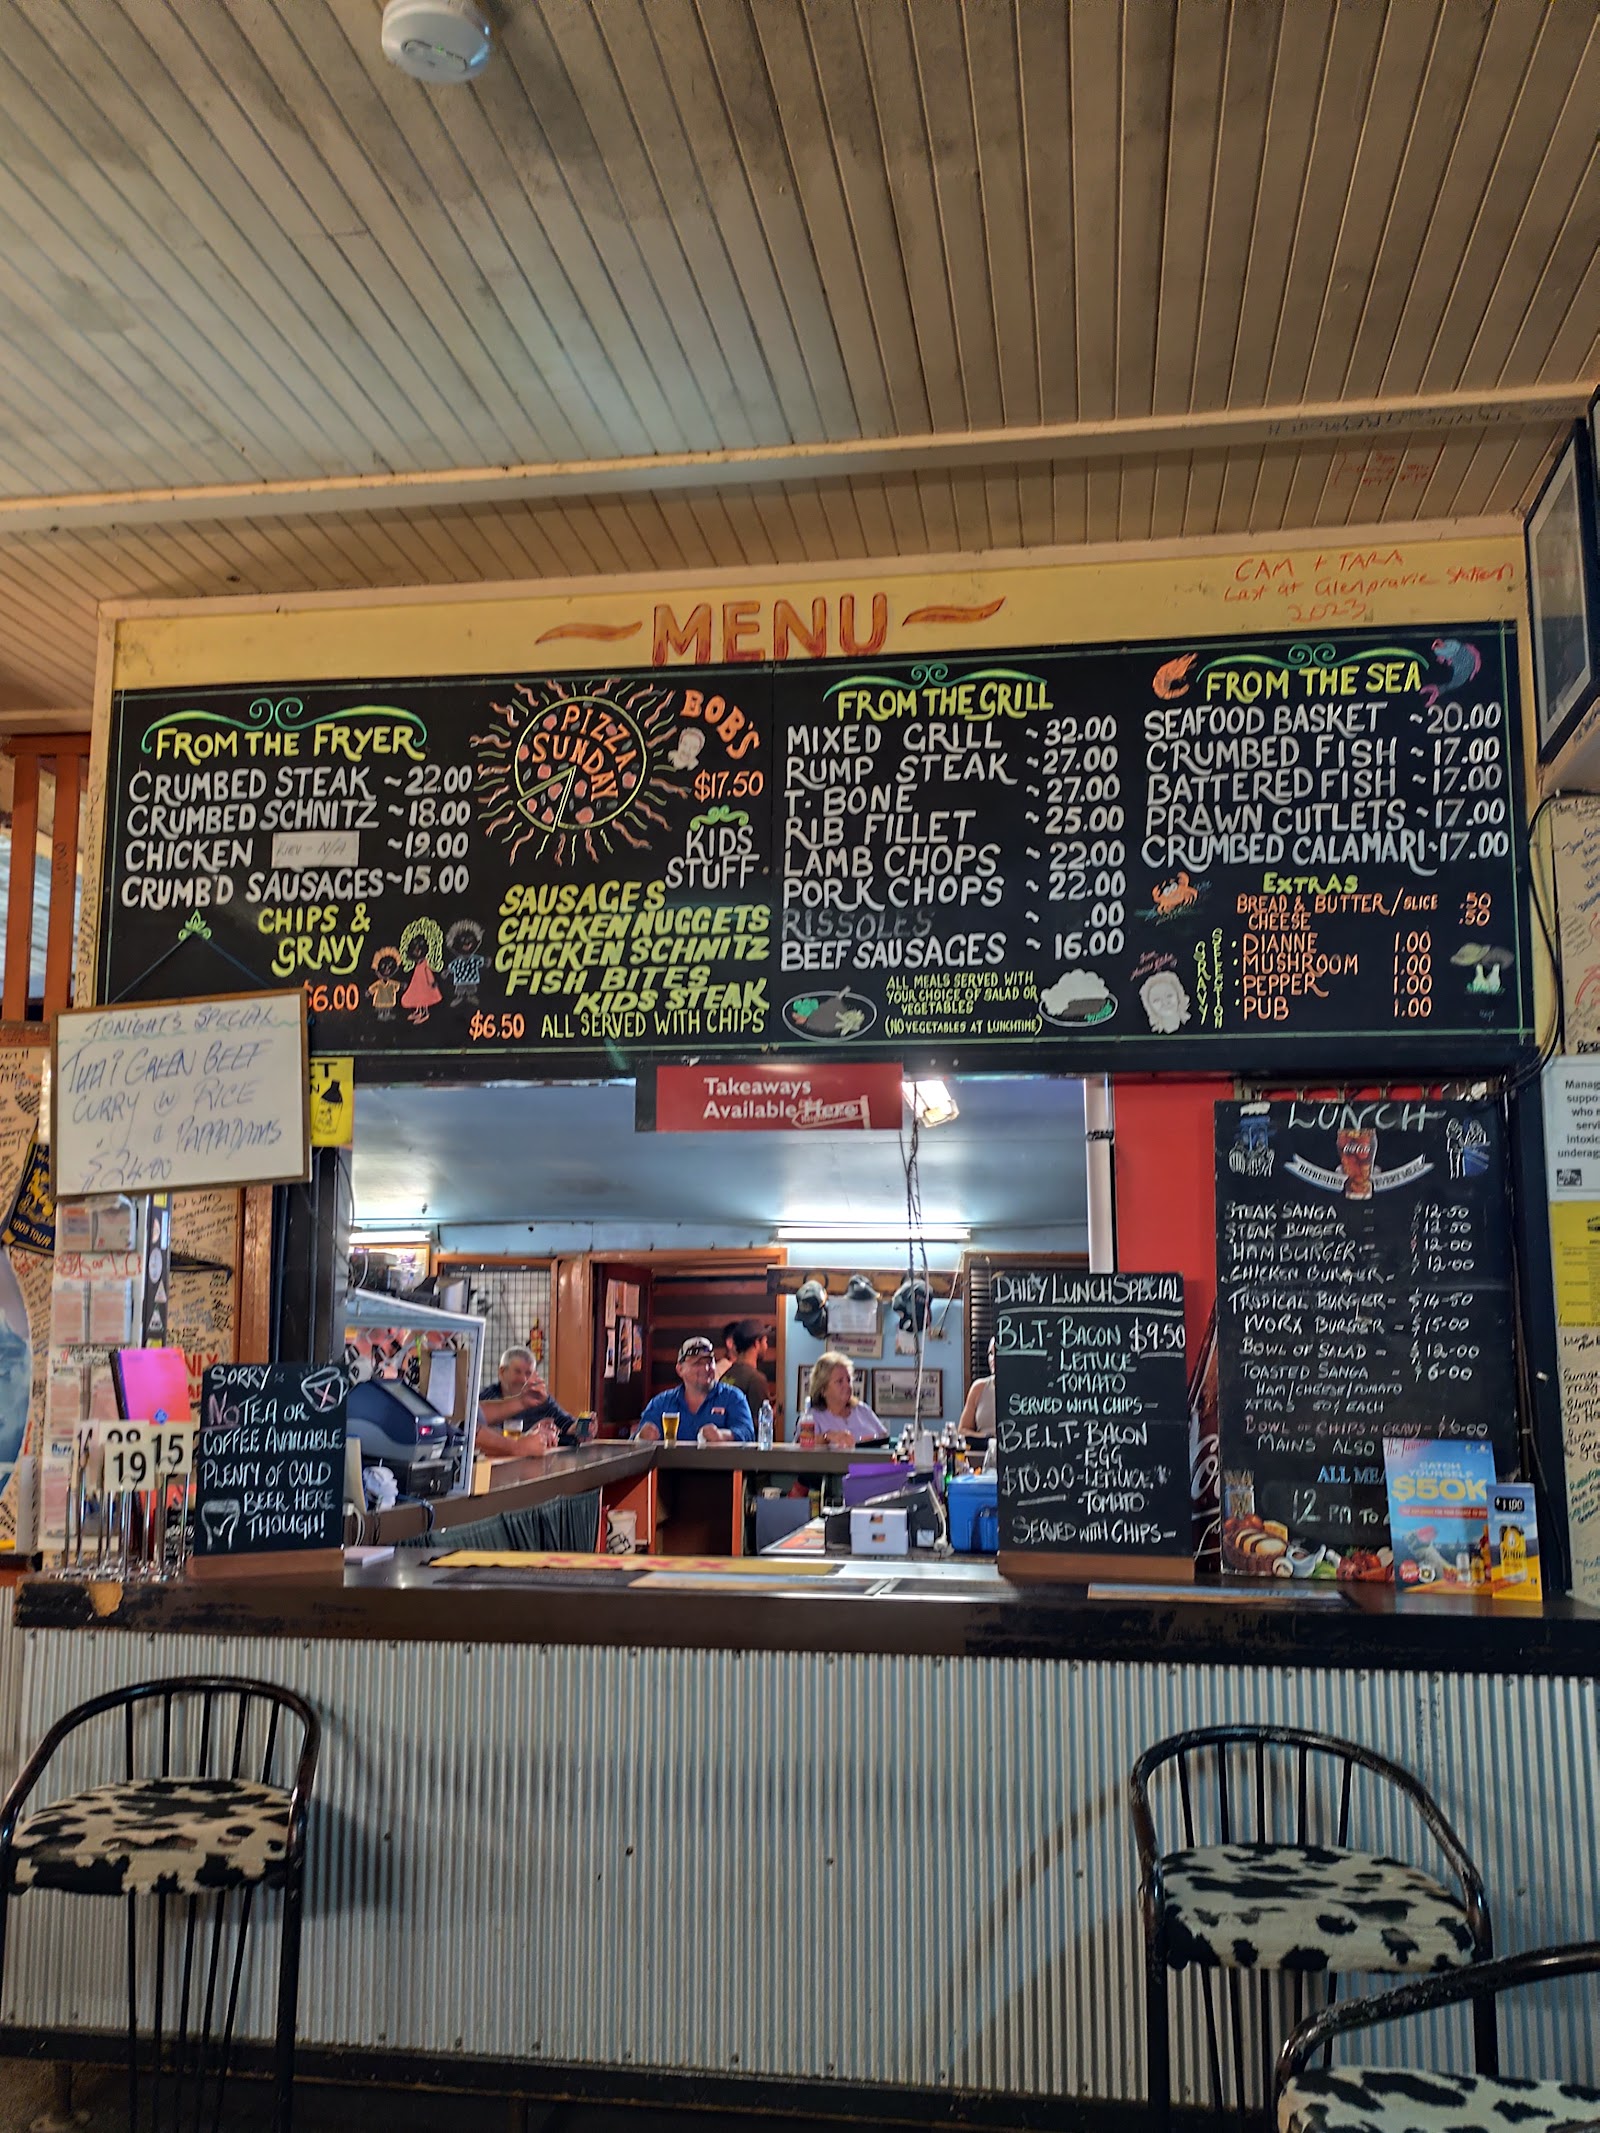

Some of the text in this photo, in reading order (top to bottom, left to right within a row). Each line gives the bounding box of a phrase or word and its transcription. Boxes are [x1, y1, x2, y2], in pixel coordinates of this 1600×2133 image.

[1235, 558, 1295, 582] CAM
[652, 592, 888, 668] MENU
[1206, 662, 1421, 703] FROM THE SEA
[837, 681, 1054, 722] FROM THE GRILL
[561, 704, 637, 770] PIZZA
[679, 689, 761, 760] BOB'S
[1144, 701, 1388, 742] SEAFOOD BASKET
[156, 722, 426, 766] FROM THE FRYER
[787, 723, 882, 755] MIXED
[903, 721, 1003, 755] GRILL
[1146, 732, 1398, 775] CRUMBED FISH
[532, 732, 620, 802] SUNDAY
[785, 752, 1018, 791] RUMP STEAK
[129, 765, 377, 807] CRUMBED STEAK
[693, 770, 765, 803] $17.50
[1147, 766, 1396, 806] BATTERED FISH
[126, 799, 380, 840] CRUMBED SCHNITZ
[785, 817, 844, 850] RIB
[864, 810, 977, 845] FILLET
[1146, 798, 1407, 837] PRAWN CUTLETS
[125, 837, 254, 873] CHICKEN
[685, 825, 754, 865] KIDS
[784, 847, 874, 879] LAMB
[883, 843, 1002, 879] CHOPS
[1141, 828, 1438, 877] CRUMBED CALAMARI
[245, 868, 385, 903] SAUSAGES
[664, 853, 760, 890] STUFF
[1263, 872, 1359, 894] EXTRAS
[499, 878, 666, 917] SAUSAGES
[783, 876, 886, 912] PORK
[887, 875, 1007, 908] CHOPS
[1236, 893, 1306, 914] BREAD &
[257, 902, 371, 935] CHIPS &
[498, 904, 771, 945] CHICKEN NUGGETS
[781, 909, 935, 941] RISSOLES
[1248, 911, 1312, 931] CHEESE
[271, 935, 365, 978] GRAVY
[495, 935, 770, 973] CHICKEN SCHNITZ
[780, 938, 856, 972] BEEF
[854, 932, 1007, 970] SAUSAGES
[1242, 930, 1432, 956] DIANNE 1.00
[505, 965, 711, 996] FISH BITES
[886, 970, 1034, 991] ALL MEALS SERVED WITH
[1212, 927, 1224, 1029] SELECTION
[1242, 952, 1432, 978] MUSHROOM 1.00
[573, 977, 770, 1016] KIDS STEAK
[886, 985, 1039, 1005] YOUR CHOICE OF SALAD OR
[1193, 940, 1211, 1025] GRAVY
[1242, 973, 1432, 997] PEPPER 1.00
[194, 1005, 277, 1031] SPECIAL
[468, 1007, 765, 1041] $6.50 ALL SERVED WITH CHIPS
[901, 1001, 975, 1015] VEGETABLES
[1243, 995, 1433, 1022] PUB 1.00
[905, 1020, 966, 1034] VEGETABLES
[970, 1020, 983, 1034] AT
[203, 1039, 274, 1075] BEEF
[703, 1077, 811, 1099] Takeaways
[73, 1091, 140, 1145] CURRY
[194, 1078, 262, 1110] RICE
[702, 1101, 856, 1119] Available Here
[1287, 1101, 1447, 1132] LUNCH
[1572, 1108, 1593, 1117] who
[1283, 1203, 1337, 1220] SANGA
[995, 1274, 1183, 1304] DAILY LUNCH SPECIAL
[1057, 1315, 1186, 1353] BACON $9.50
[1059, 1350, 1137, 1372] LETTUCE
[1241, 1361, 1368, 1379] TOASTED SANGA
[210, 1365, 272, 1391] SORRY
[1057, 1373, 1126, 1394] TOMATO
[239, 1395, 310, 1425] TEA OR
[1009, 1394, 1099, 1416] SERVED WITH
[203, 1427, 345, 1456] COFFEE AVAILABLE
[1084, 1422, 1148, 1446] BACON
[1257, 1435, 1316, 1452] MAINS
[1332, 1438, 1375, 1456] ALSO
[152, 1434, 184, 1467] 15
[1084, 1446, 1122, 1469] EGG
[113, 1452, 147, 1483] 19
[201, 1458, 331, 1490] PLENTY OF COLD
[1317, 1465, 1351, 1484] ALL
[244, 1489, 335, 1516] BEER HERE
[1083, 1491, 1145, 1514] TOMATO
[1391, 1475, 1488, 1502] $50K
[1293, 1488, 1320, 1524] 12
[246, 1511, 326, 1541] THOUGH!
[1013, 1516, 1108, 1544] SERVED WITH
